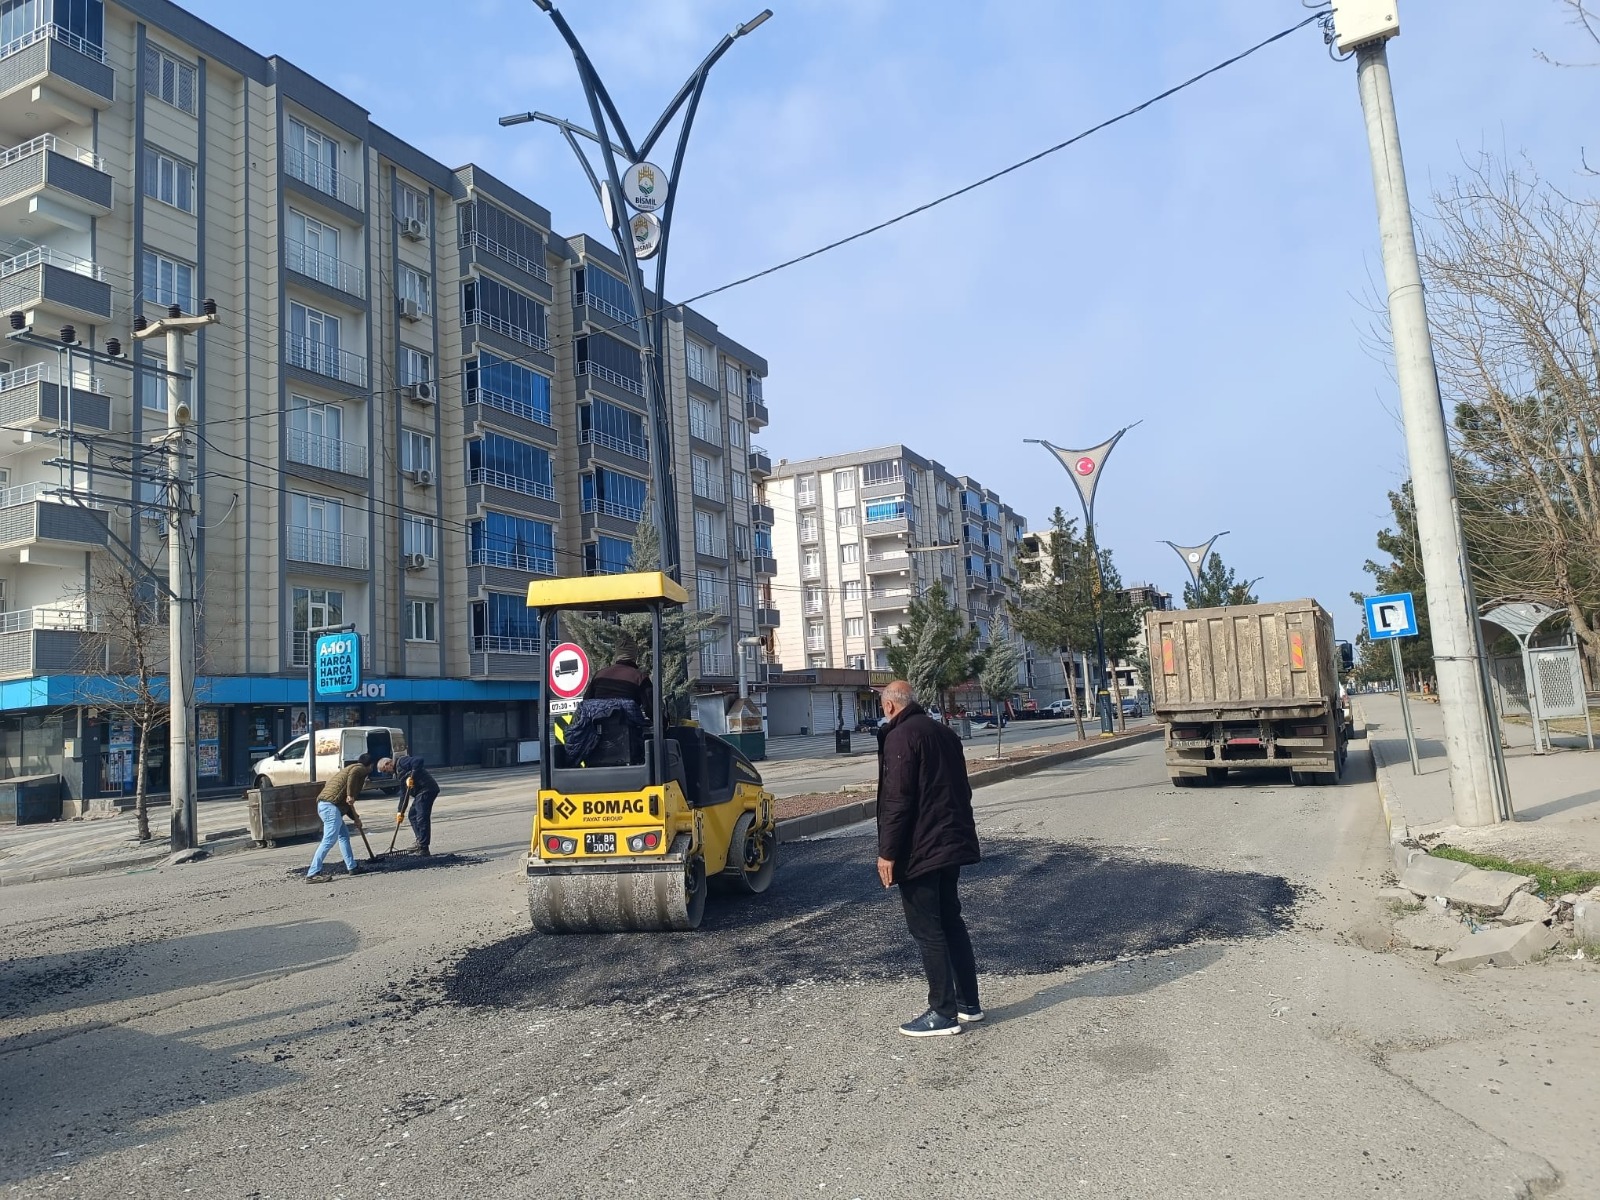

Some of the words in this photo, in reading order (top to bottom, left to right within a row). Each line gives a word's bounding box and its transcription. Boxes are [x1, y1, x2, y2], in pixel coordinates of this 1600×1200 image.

[320, 640, 352, 655] A-101
[320, 654, 352, 667] HARCA
[320, 664, 352, 677] HARCA
[583, 799, 644, 815] BOMAG
[586, 834, 595, 843] 21
